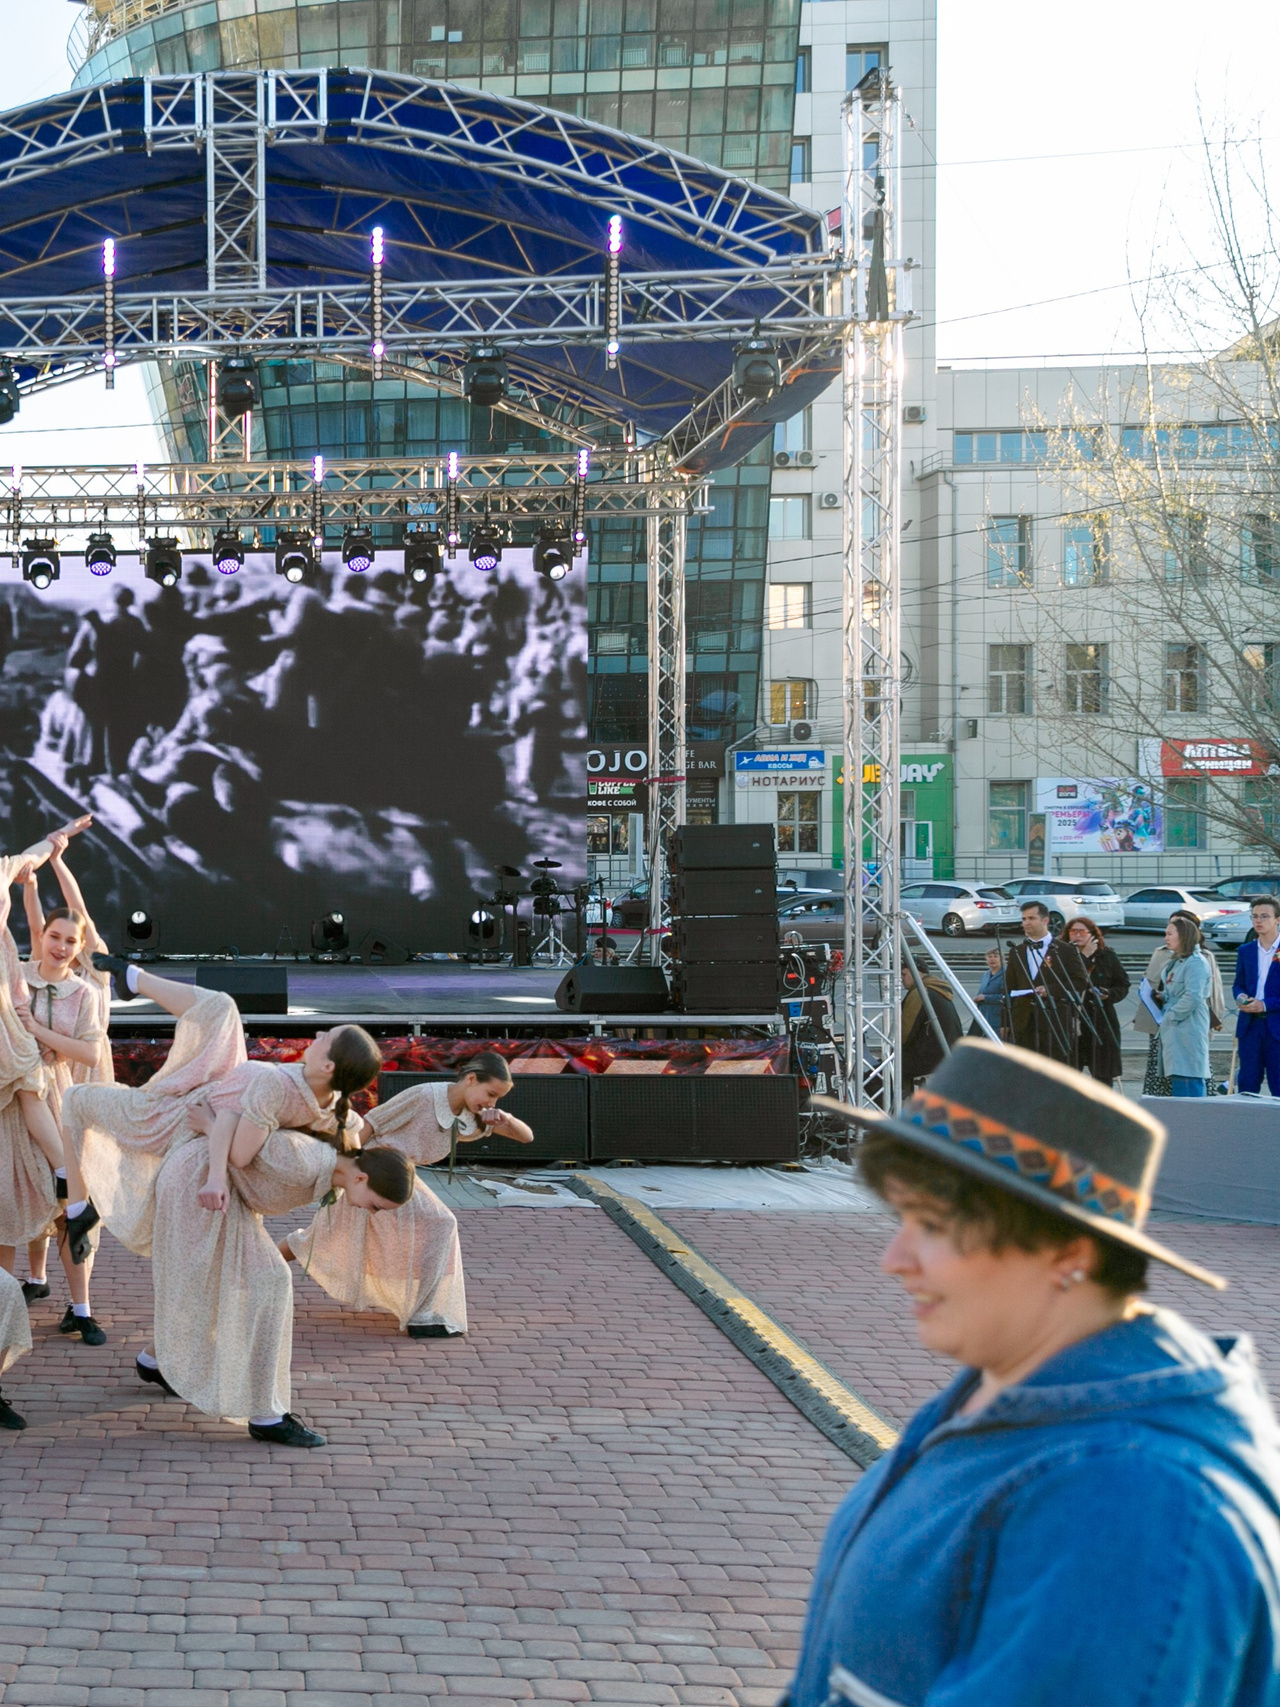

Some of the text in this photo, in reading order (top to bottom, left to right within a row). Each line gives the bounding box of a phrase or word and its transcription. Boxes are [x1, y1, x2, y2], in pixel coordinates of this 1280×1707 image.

[698, 760, 717, 769] BAR
[752, 776, 826, 787] НОТАРИУС
[597, 786, 621, 795] LIKE
[614, 799, 637, 807] СОБОЙ
